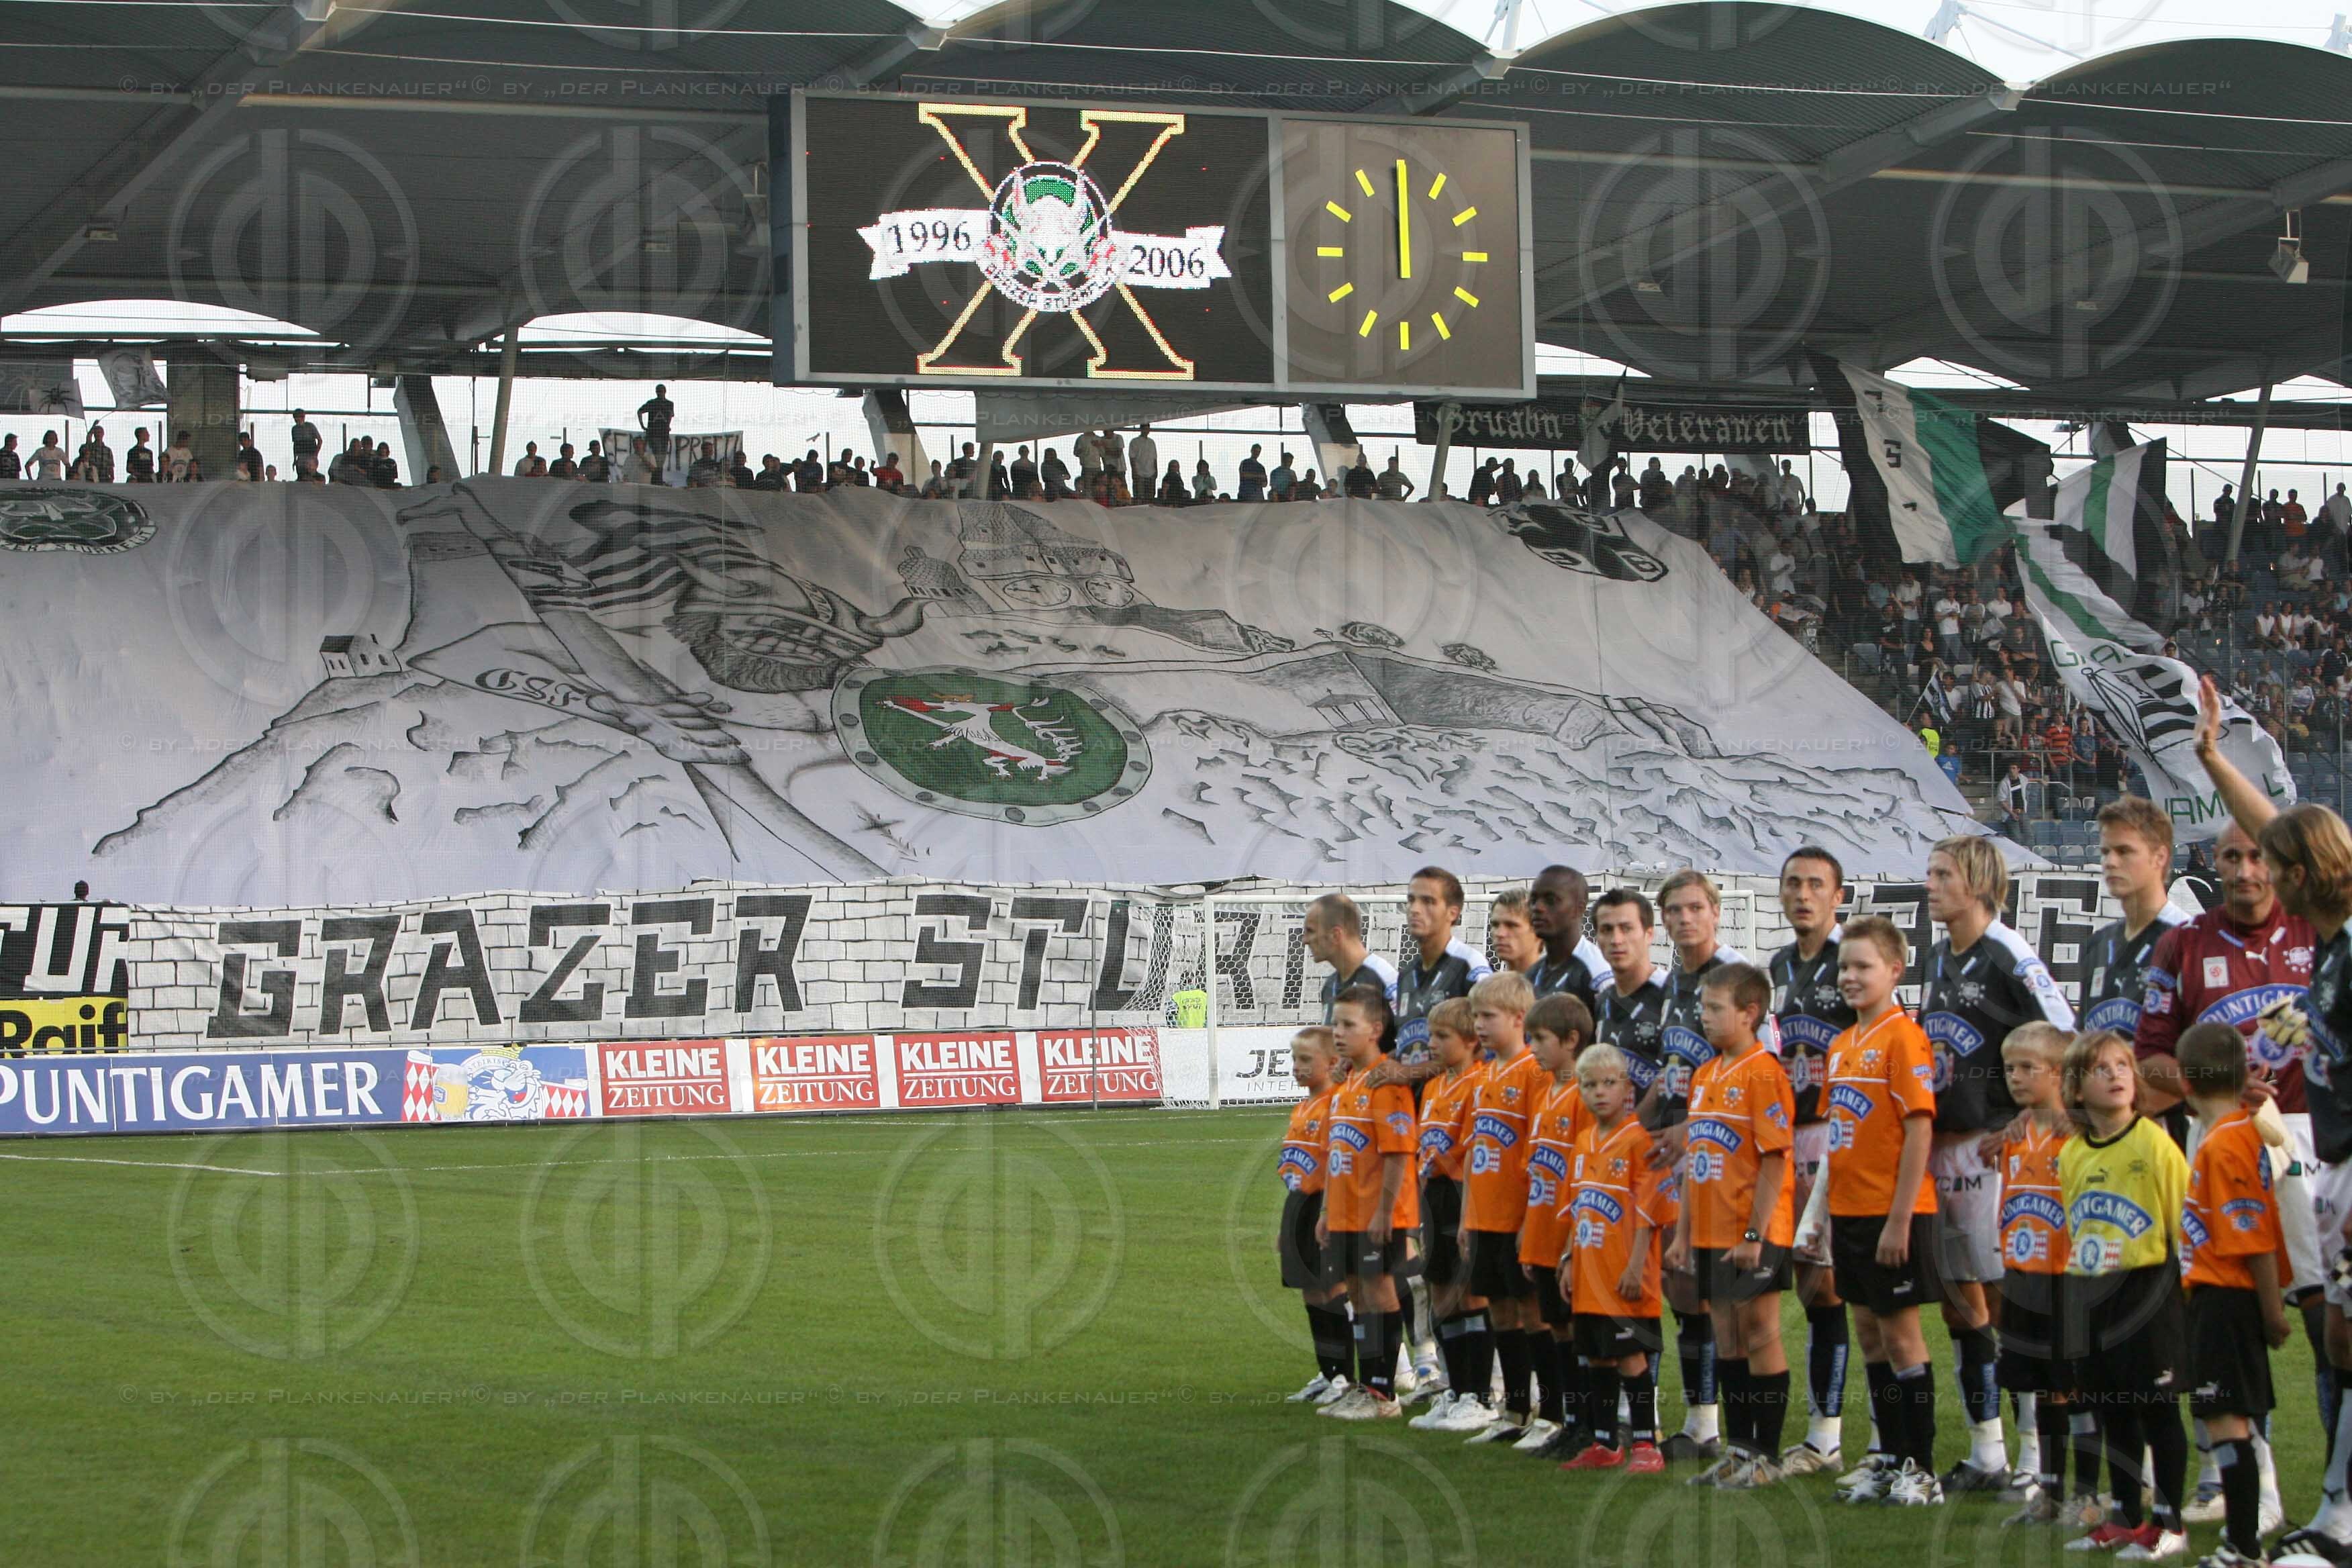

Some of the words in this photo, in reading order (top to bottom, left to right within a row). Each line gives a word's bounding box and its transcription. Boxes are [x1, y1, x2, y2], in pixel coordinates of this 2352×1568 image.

[887, 220, 971, 254] 1996
[1128, 246, 1205, 278] 2006
[207, 893, 813, 1038] GRAZER
[606, 1048, 718, 1078] KLEINE
[757, 1044, 869, 1074] KLEINE
[901, 1040, 1012, 1071] KLEINE
[1044, 1035, 1150, 1067] KLEINE
[609, 1081, 725, 1108] ZEITUNG
[759, 1077, 873, 1106] ZEITUNG
[904, 1074, 1019, 1101] ZEITUNG
[1047, 1071, 1157, 1099] ZEITUNG
